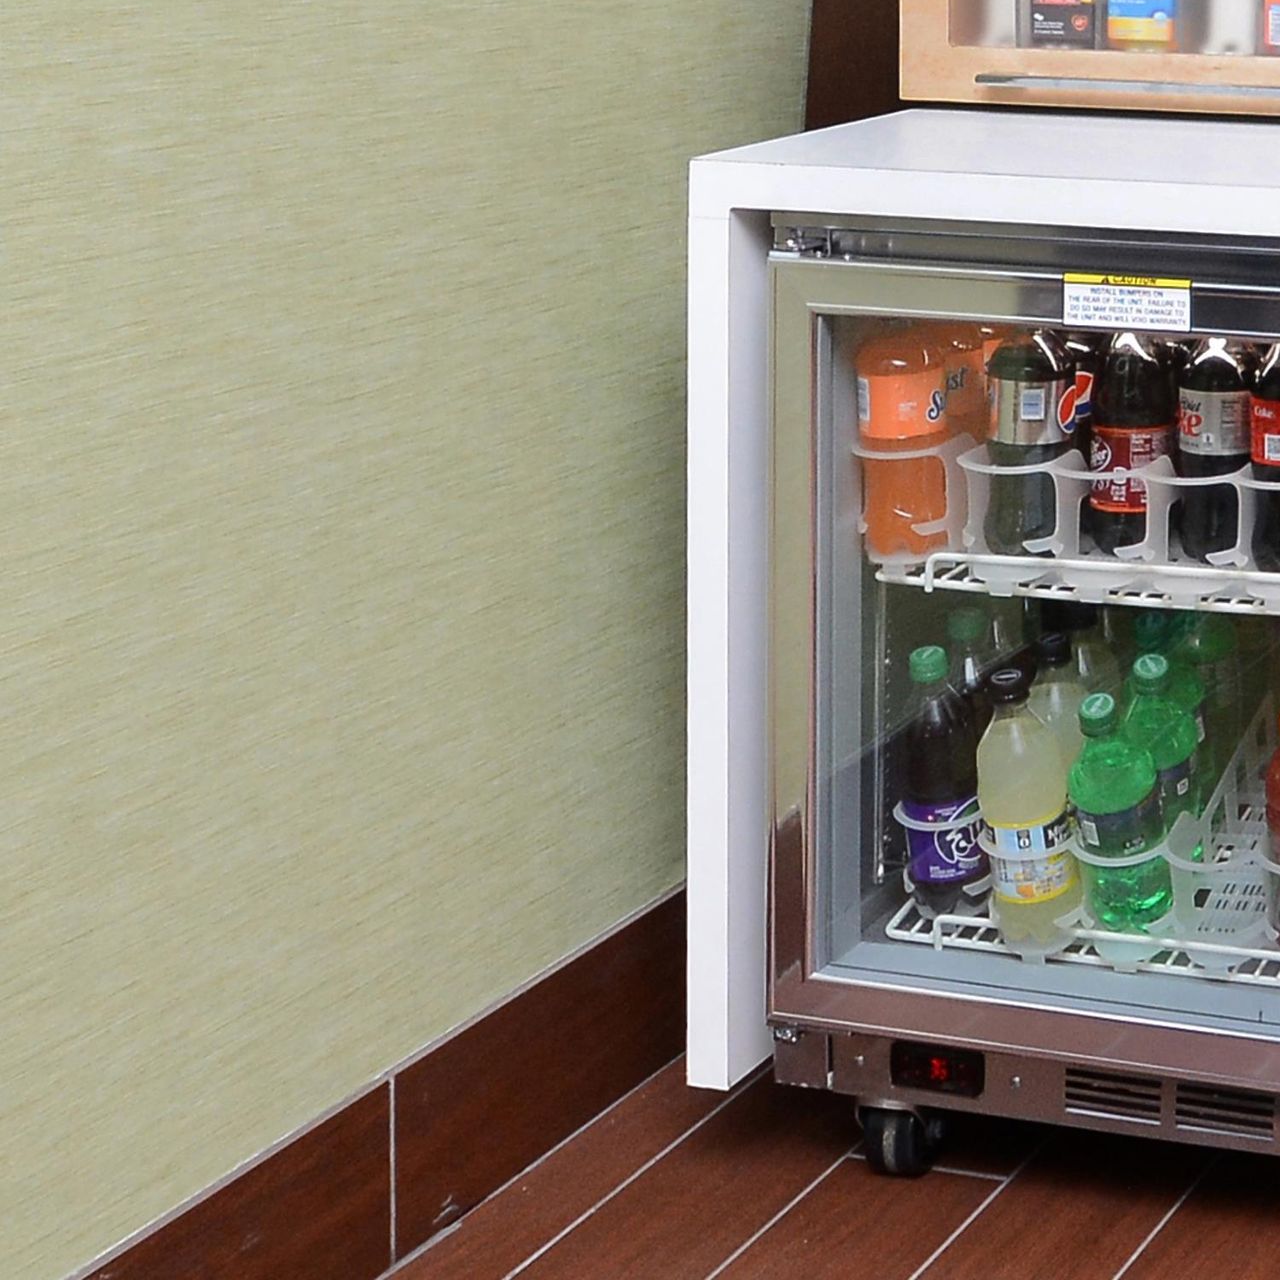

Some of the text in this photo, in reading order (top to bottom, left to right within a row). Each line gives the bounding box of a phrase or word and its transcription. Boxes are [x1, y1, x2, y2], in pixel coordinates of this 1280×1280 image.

[1113, 276, 1158, 285] CAUTION
[1090, 287, 1117, 295] INSTALL
[1119, 288, 1151, 296] BUMPERS
[1113, 297, 1125, 305] THE
[1147, 299, 1174, 307] FAILURE
[1177, 300, 1187, 308] TO
[1070, 304, 1080, 312] DO
[1093, 305, 1107, 313] MAY
[1109, 306, 1133, 314] RESULT
[1144, 307, 1172, 316] DAMAGE
[1150, 317, 1187, 325] WARRANTY
[1254, 406, 1275, 419] Coke
